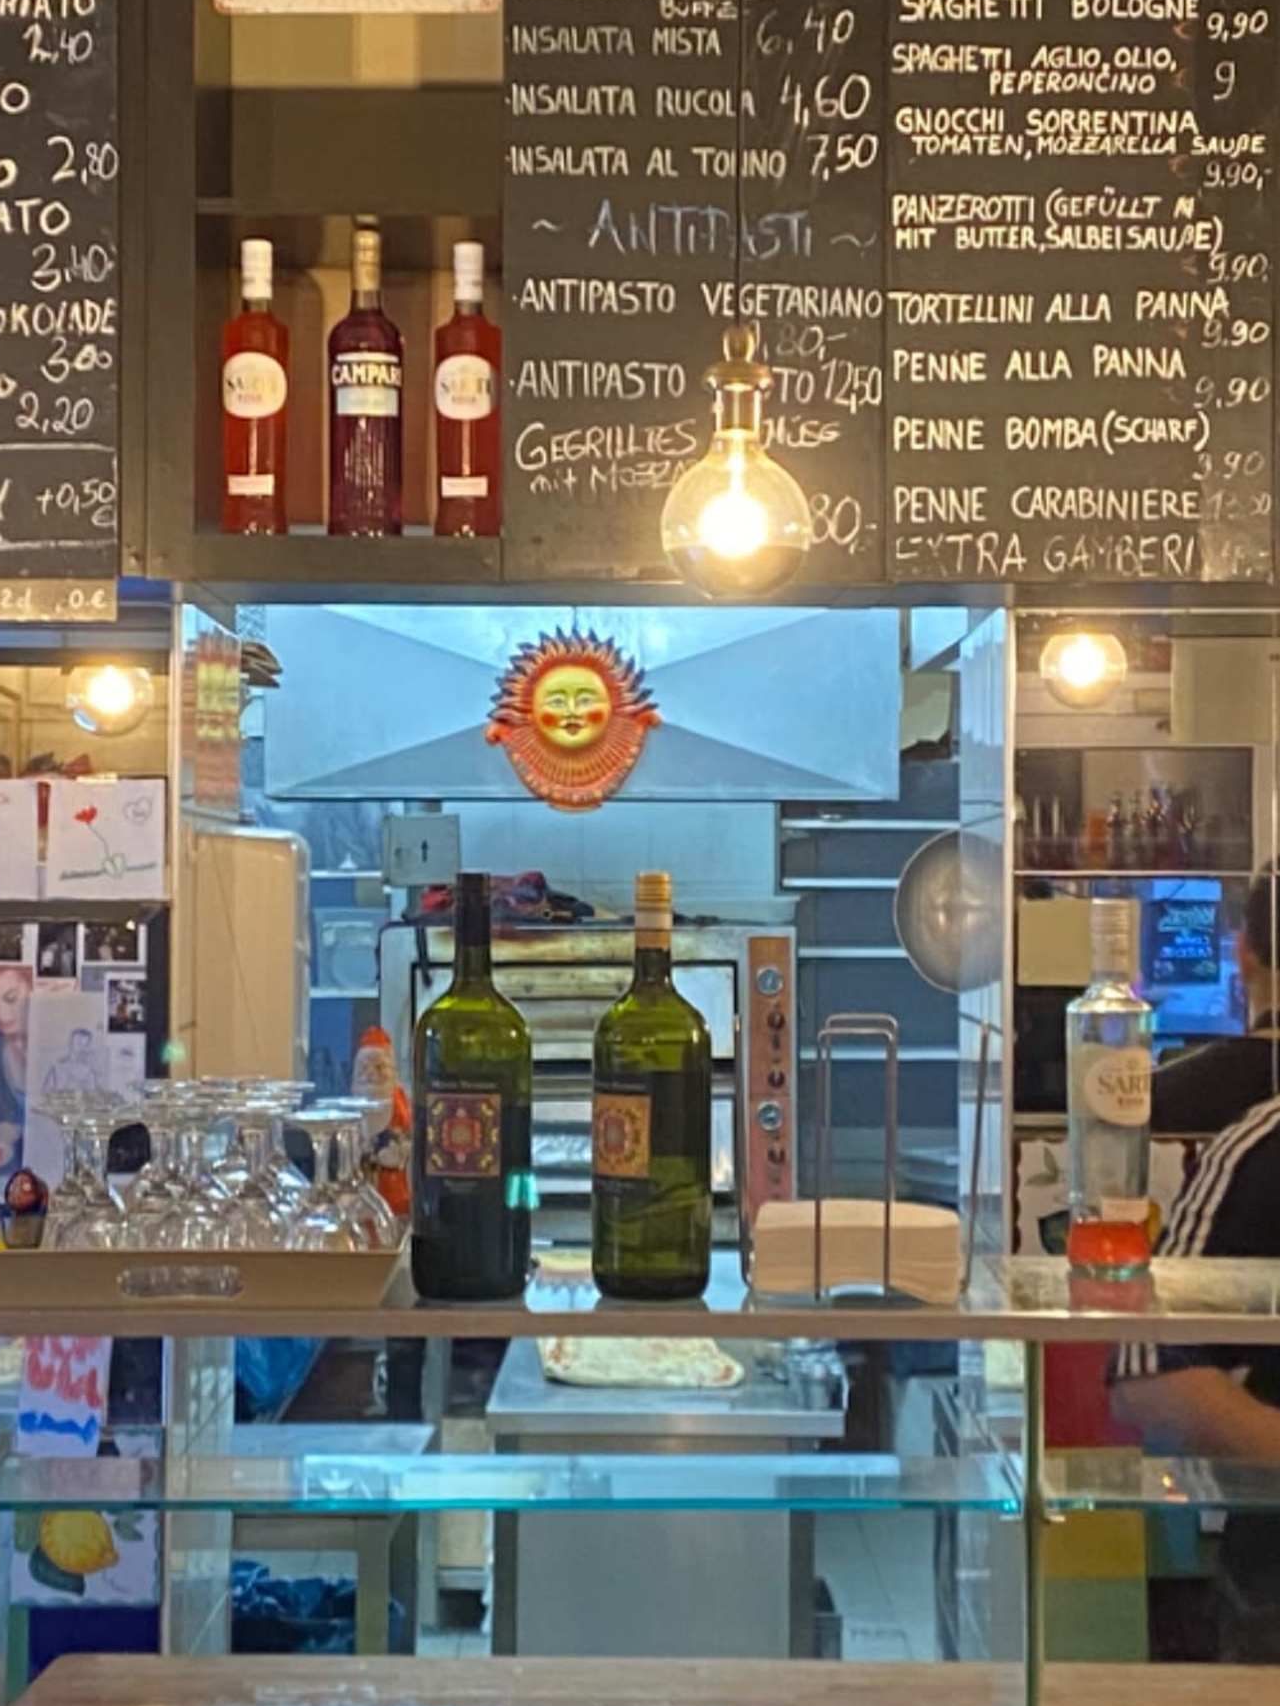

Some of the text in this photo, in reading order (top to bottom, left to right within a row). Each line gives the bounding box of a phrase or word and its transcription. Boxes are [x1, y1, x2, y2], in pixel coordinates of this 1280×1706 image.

[512, 25, 722, 56] INSALATA MISTA
[511, 83, 756, 118] INSALATA RUCOLA
[989, 71, 1155, 95] PEPERONCINO
[895, 106, 1199, 139] GNOCCHI SORRENTINA
[510, 145, 629, 177] INSALATA
[646, 147, 679, 177] AL
[892, 193, 1035, 227] PANZEROTTI
[519, 278, 883, 319] ANTIPASTO VEGETARIANO
[887, 286, 1230, 325] TORTELLINI ALLA PANNA
[516, 360, 686, 400] ANTIPASTO
[893, 344, 1187, 383] PENNE ALLA PANNA
[893, 415, 984, 452] PENNE
[893, 485, 1204, 524] PENNE CARABINIERE
